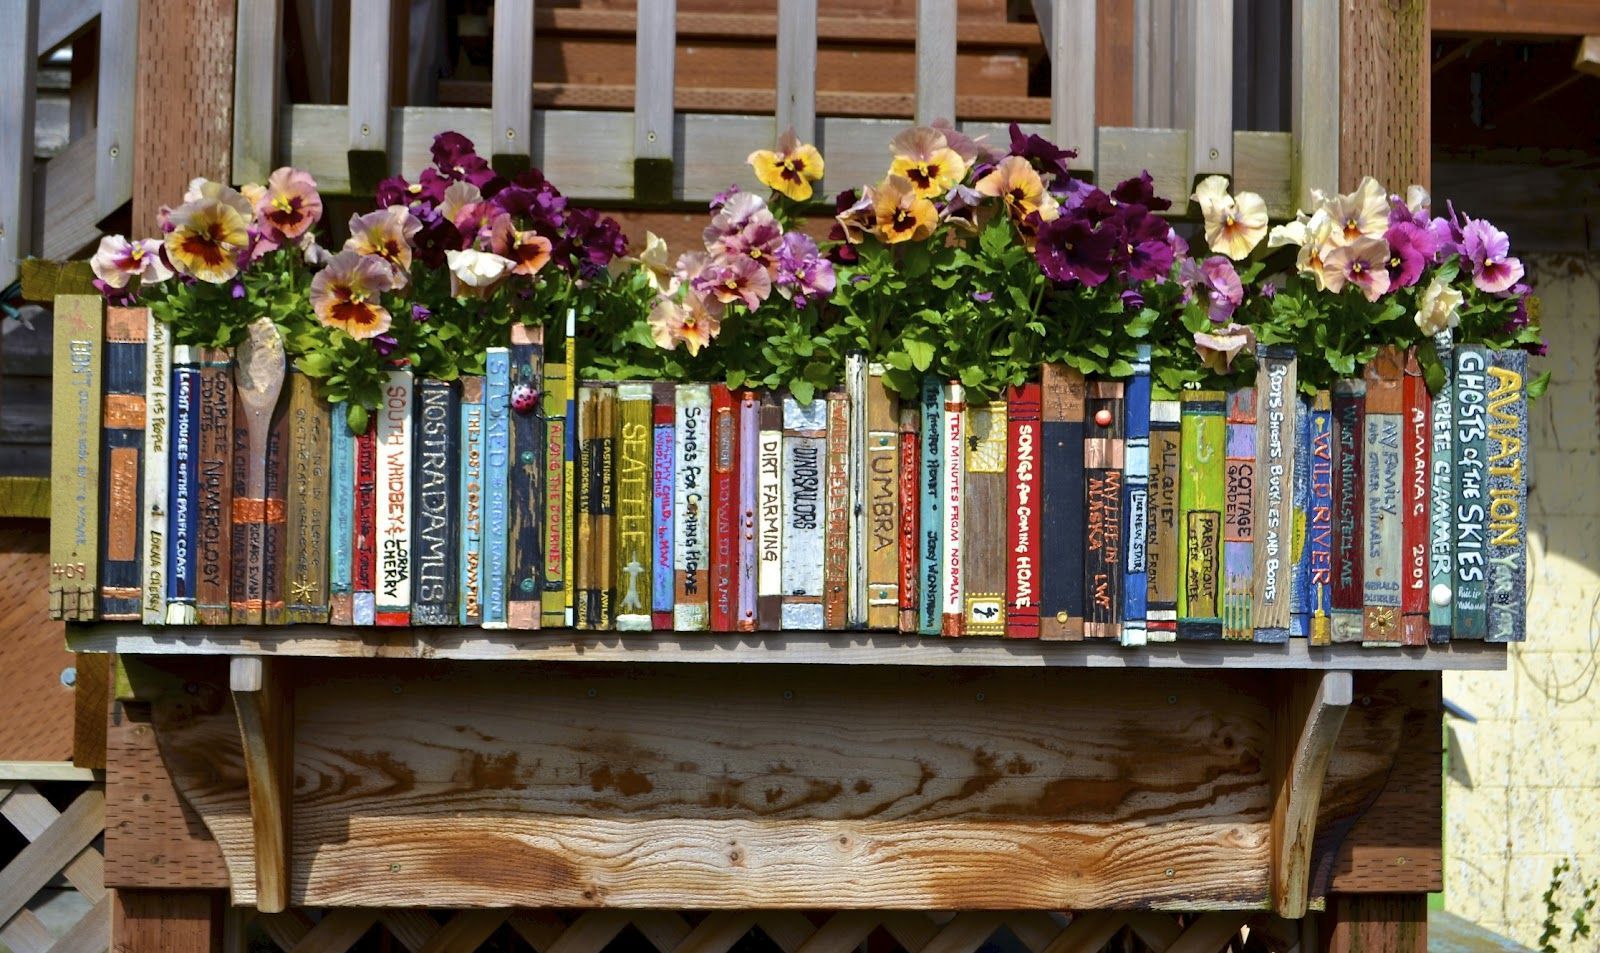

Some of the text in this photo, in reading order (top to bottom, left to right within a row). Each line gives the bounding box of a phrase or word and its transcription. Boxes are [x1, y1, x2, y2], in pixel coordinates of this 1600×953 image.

[178, 372, 190, 411] LIGHT
[214, 370, 229, 454] COMPLETE
[386, 386, 406, 446] SOUTH
[488, 359, 507, 468] STOKED
[1457, 350, 1487, 443] GHOSTS
[151, 417, 166, 453] PEOPLE
[359, 432, 372, 478] TUITIVE
[601, 438, 611, 484] CASTING
[684, 407, 701, 463] SONGS
[1016, 424, 1032, 480] SONGS
[1340, 404, 1358, 450] WHAT
[1487, 365, 1523, 547] AVIATION
[386, 451, 405, 525] WHIDBEY
[420, 389, 449, 602] NOSTRADAMUS
[548, 424, 562, 575] ALONG THE JOURNEY
[620, 422, 647, 548] SEATTLE
[761, 441, 778, 563] DIRT FARMING
[1162, 439, 1178, 529] ALL QUIET
[1225, 465, 1238, 526] GARDEN
[1236, 463, 1253, 538] COTTAGE
[1269, 464, 1284, 529] BUCKLES
[1378, 420, 1401, 516] MY FAMILY
[1410, 407, 1427, 591] ALMANAC 2009
[1460, 467, 1483, 500] THE
[177, 498, 188, 538] PACIFIC
[465, 409, 482, 617] THE LOST COAST KAMPION
[871, 456, 894, 553] UMBRA
[949, 414, 960, 606] TEN MINUTES FROM NORMAL
[1014, 506, 1031, 553] COMING
[1087, 477, 1105, 552] ALASKA
[1100, 470, 1121, 564] MY LIFE IN
[1132, 494, 1146, 512] LIKE
[1134, 513, 1144, 541] NEW
[1147, 463, 1161, 596] THE WESTERN FRONT
[1311, 430, 1333, 585] WILD RIVER
[1369, 496, 1383, 559] ANIMALS
[1430, 460, 1452, 582] CLAMMER
[145, 530, 162, 613] LORNA CHERRY
[176, 540, 187, 581] COAST
[383, 539, 398, 599] CHERRY
[395, 539, 408, 583] LORNA
[683, 550, 700, 597] HOME
[1265, 529, 1279, 557] AND
[1456, 503, 1485, 583] SKIES
[1015, 556, 1032, 610] HOME
[1263, 559, 1281, 602] BOOTS
